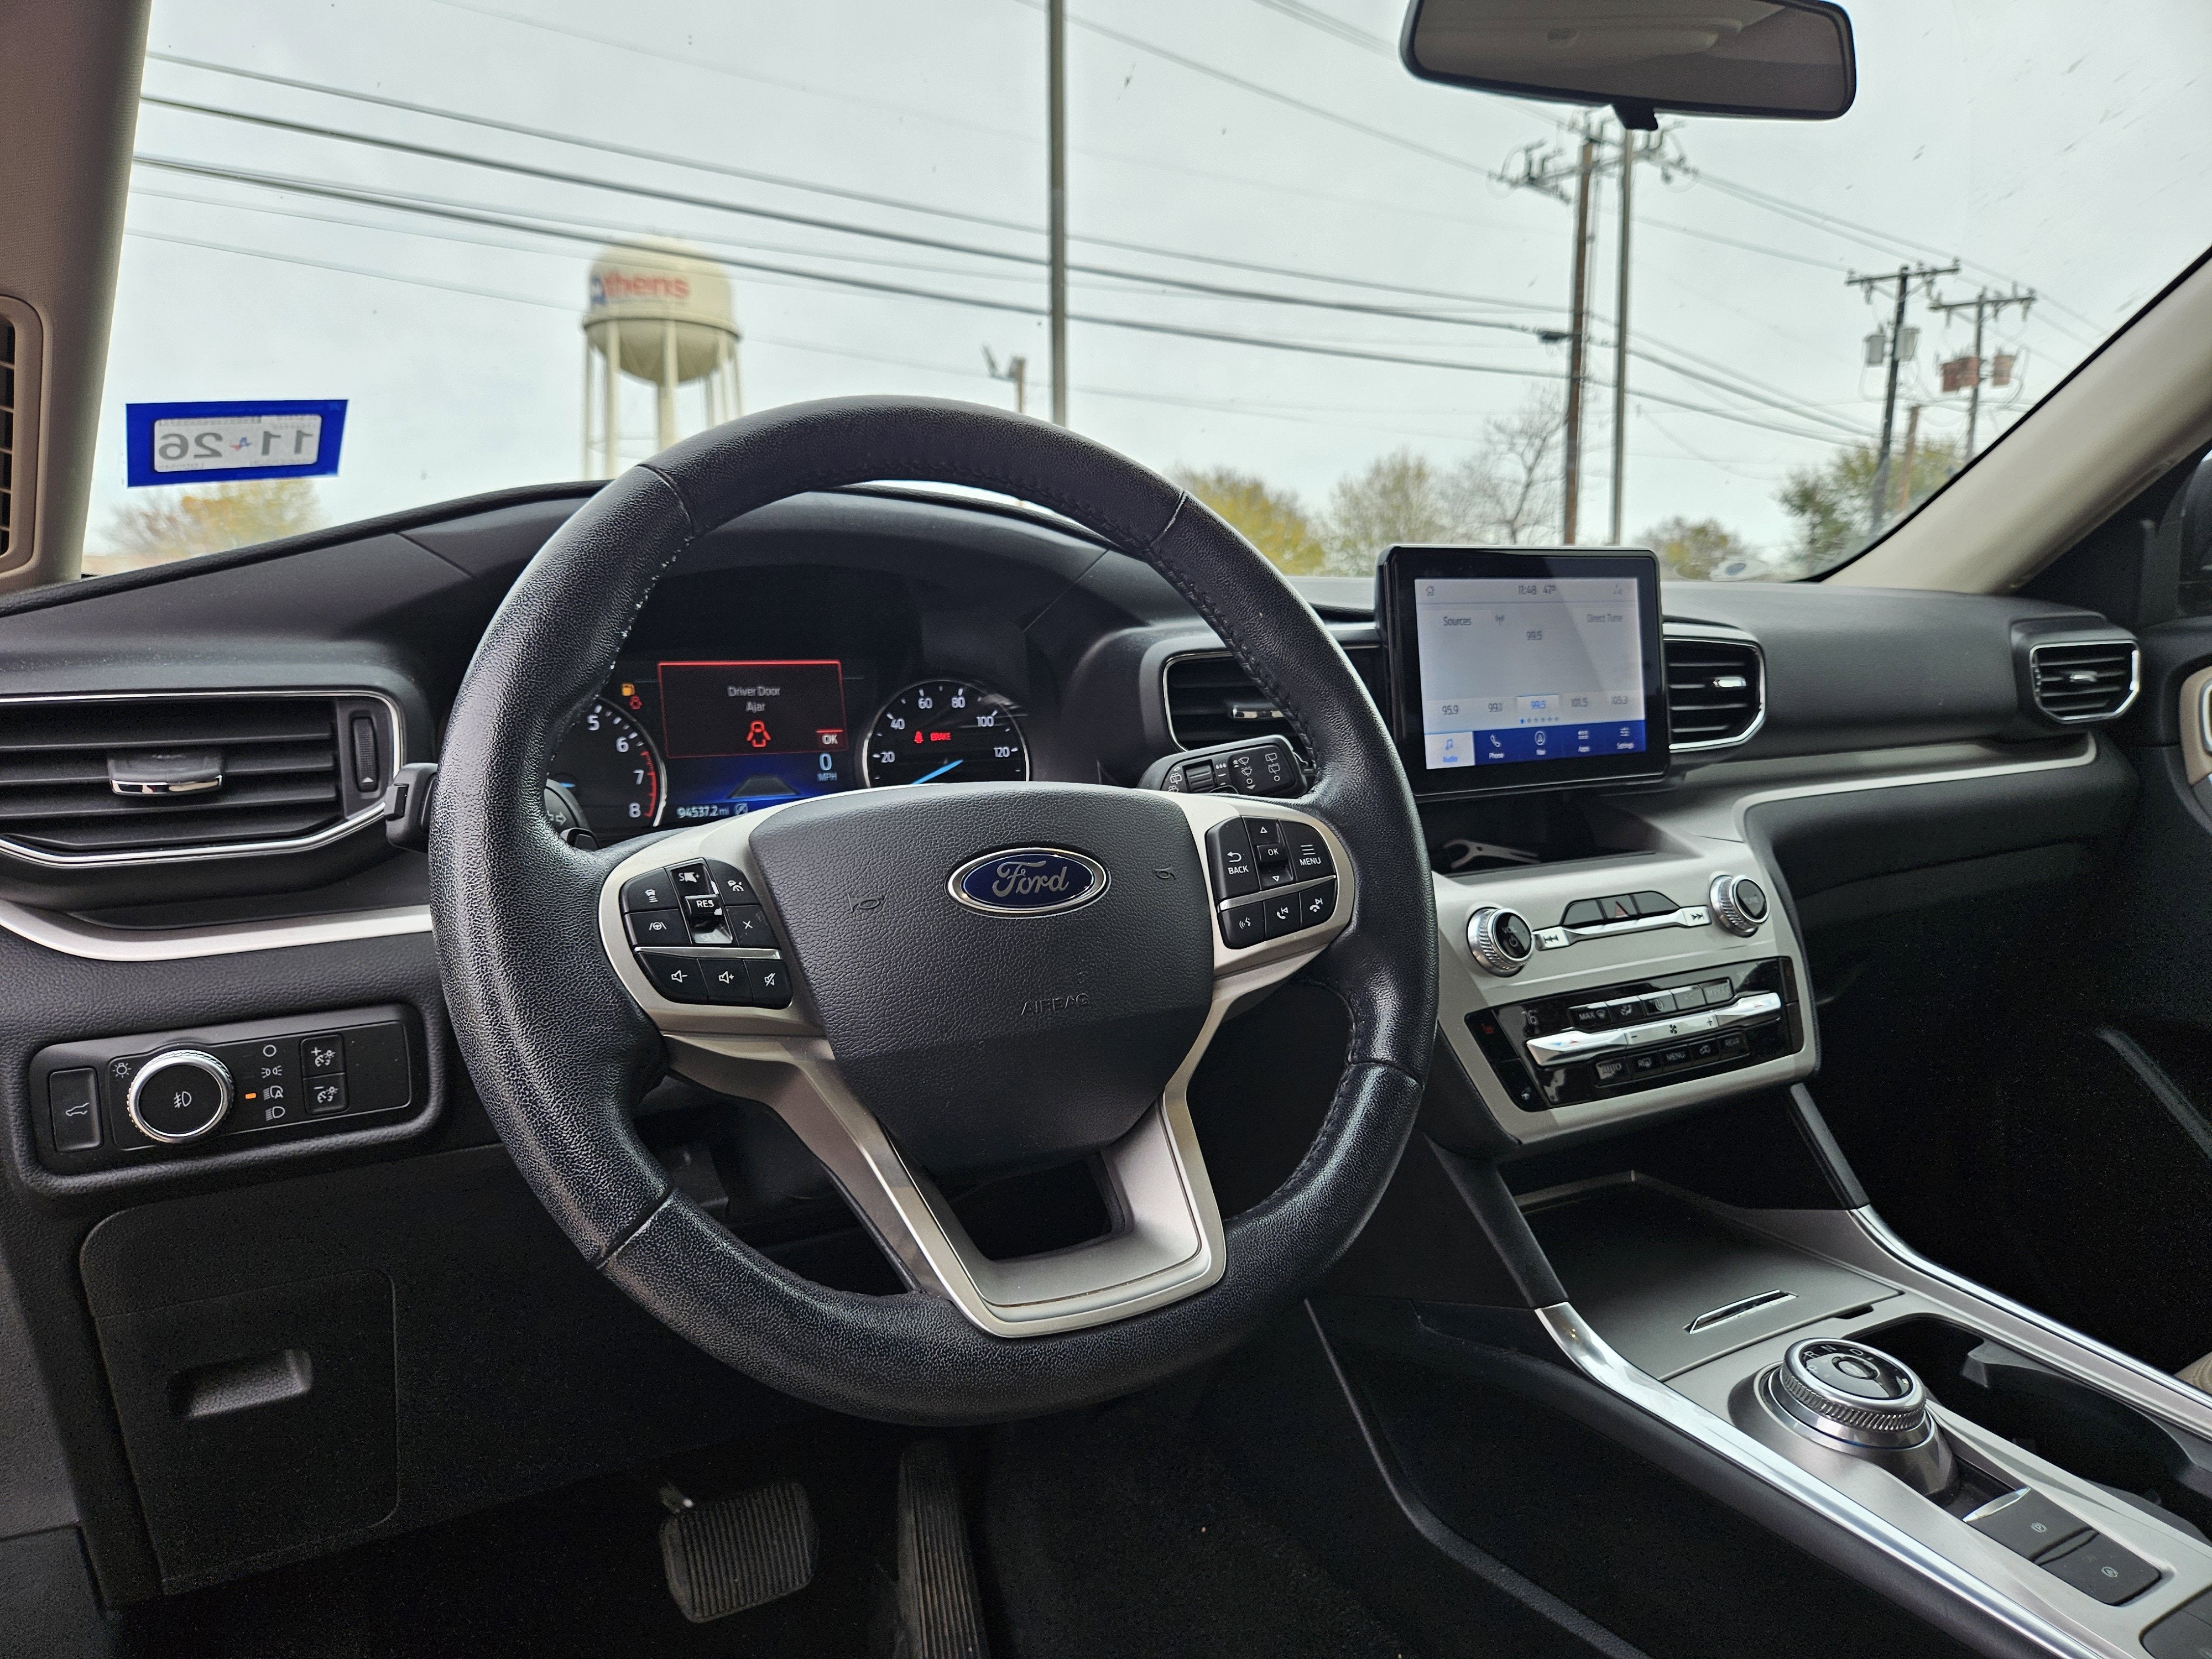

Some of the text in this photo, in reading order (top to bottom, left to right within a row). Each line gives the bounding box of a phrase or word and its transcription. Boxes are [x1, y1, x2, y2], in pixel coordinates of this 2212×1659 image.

[1443, 616, 1472, 626] Sources
[727, 685, 780, 697] Driver Door
[746, 701, 765, 713] Ajar
[918, 697, 933, 709] 60
[951, 697, 966, 708] 80
[1442, 705, 1459, 715] 95.9
[587, 714, 600, 731] 5
[890, 719, 905, 730] 40
[976, 716, 994, 727] 100
[822, 734, 838, 744] OK
[930, 732, 951, 742] BRAKE
[616, 736, 629, 753] 6
[881, 751, 895, 763] 20
[994, 747, 1010, 758] 120
[819, 753, 832, 771] 0
[633, 769, 644, 785] 7
[817, 773, 837, 781] MPH
[629, 802, 641, 818] 8
[1267, 848, 1279, 856] OK
[1300, 857, 1322, 867] MENU
[1228, 865, 1249, 875] BACK
[993, 860, 1070, 897] Ford
[696, 899, 714, 907] RES
[1021, 993, 1089, 1016] AIRBAG
[1578, 1012, 1595, 1021] MAX
[1666, 1052, 1686, 1061] MENU
[1601, 1062, 1622, 1074] AUTO
[1820, 1344, 1837, 1353] N
[1803, 1350, 1820, 1359] R
[1807, 1365, 1819, 1374] P
